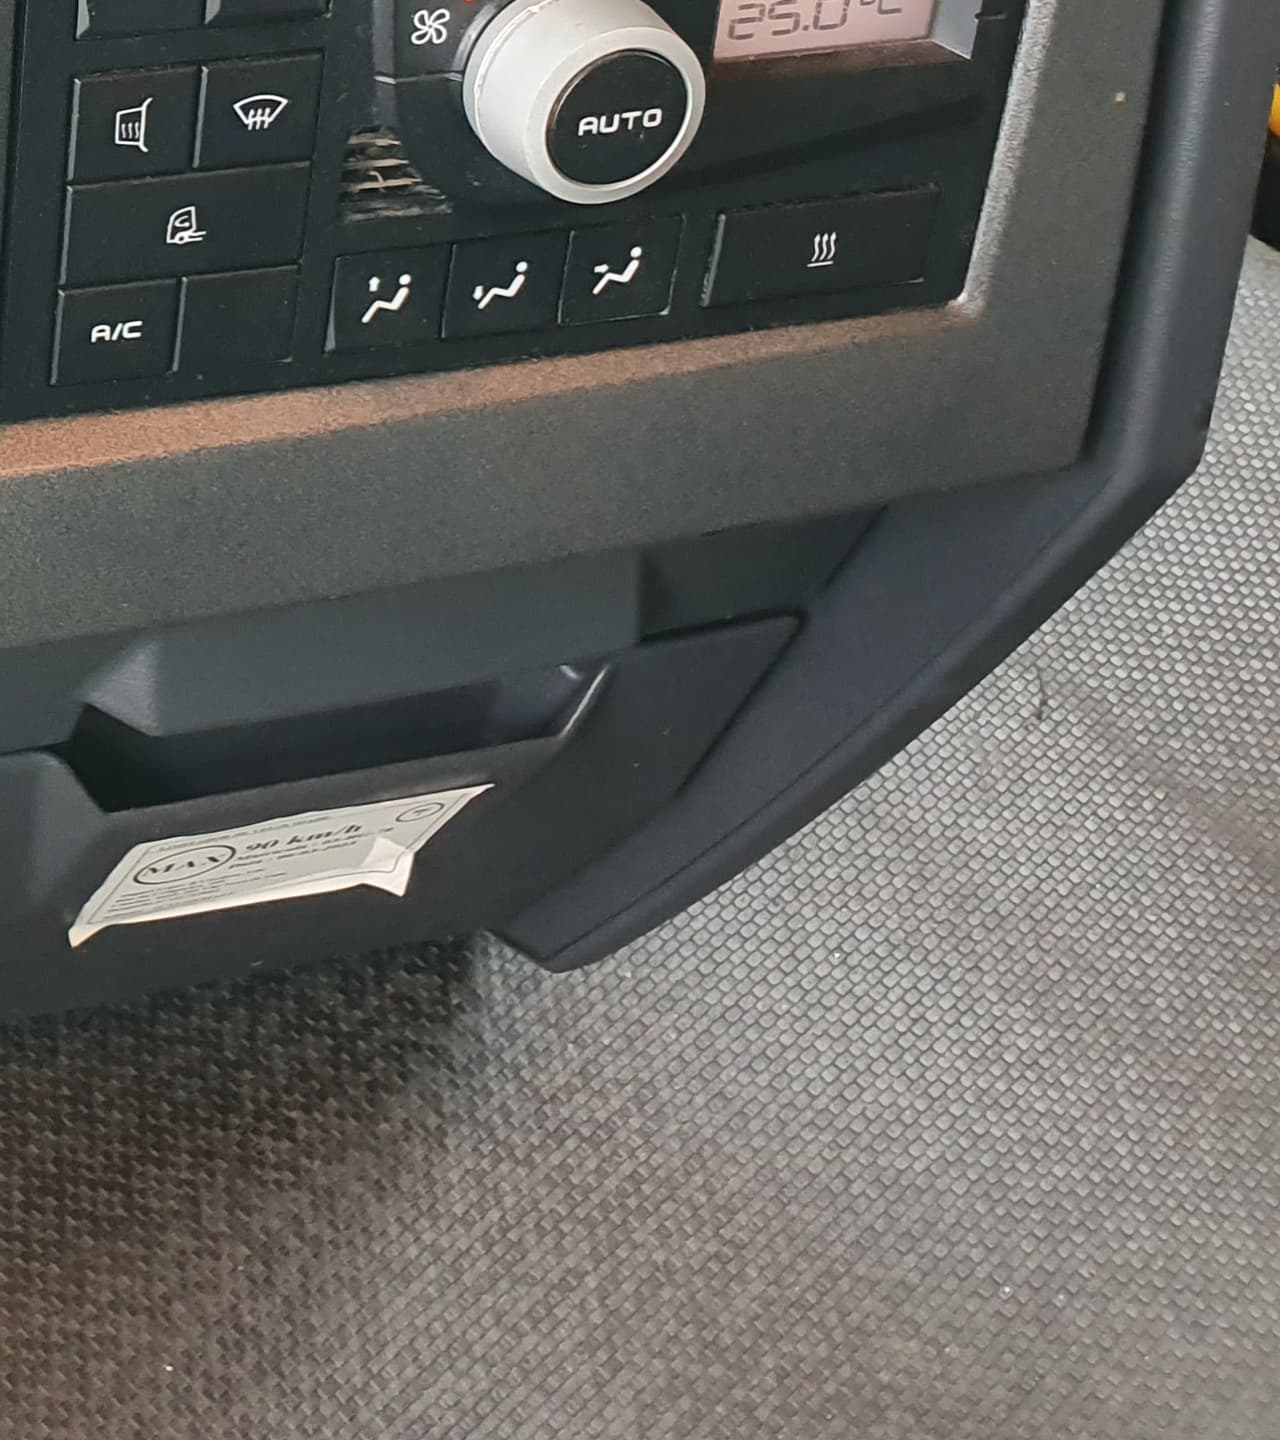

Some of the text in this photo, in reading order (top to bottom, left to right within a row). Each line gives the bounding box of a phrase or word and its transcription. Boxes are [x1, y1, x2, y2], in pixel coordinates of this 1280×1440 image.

[578, 108, 662, 137] AUTO
[91, 320, 143, 343] A/C
[245, 840, 279, 851] 90
[287, 824, 362, 845] km/h
